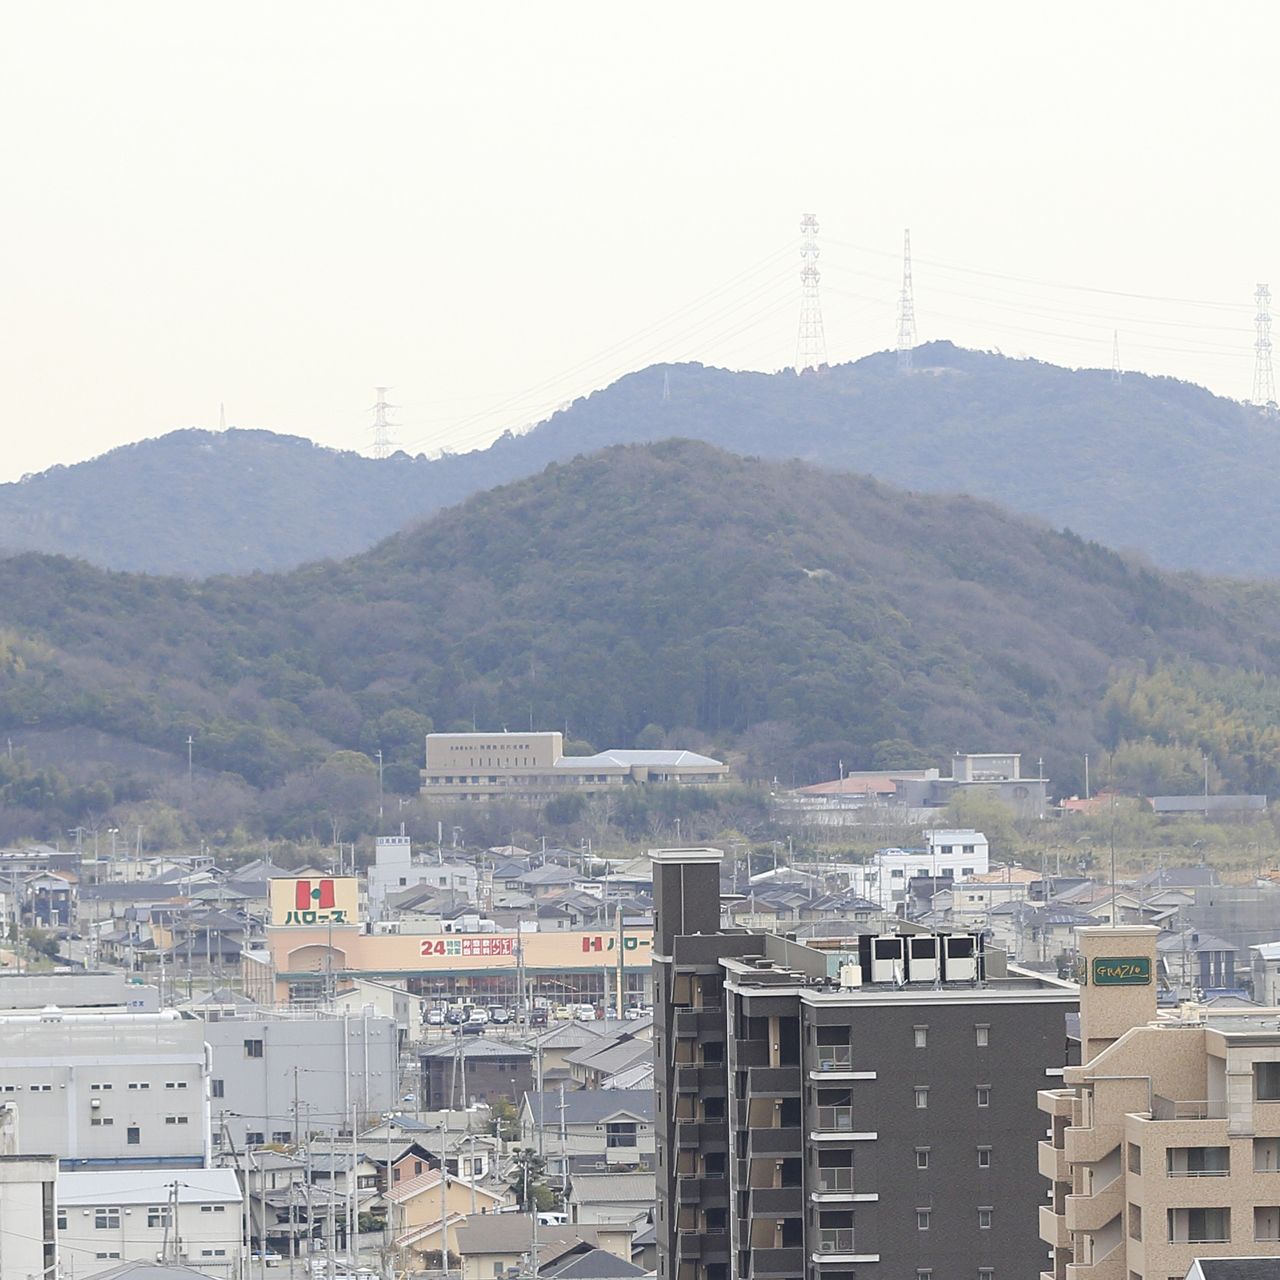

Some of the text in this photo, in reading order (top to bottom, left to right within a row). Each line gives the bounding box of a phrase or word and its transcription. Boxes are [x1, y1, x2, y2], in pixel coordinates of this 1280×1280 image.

[285, 911, 347, 925] ハローズ
[421, 941, 446, 955] 24
